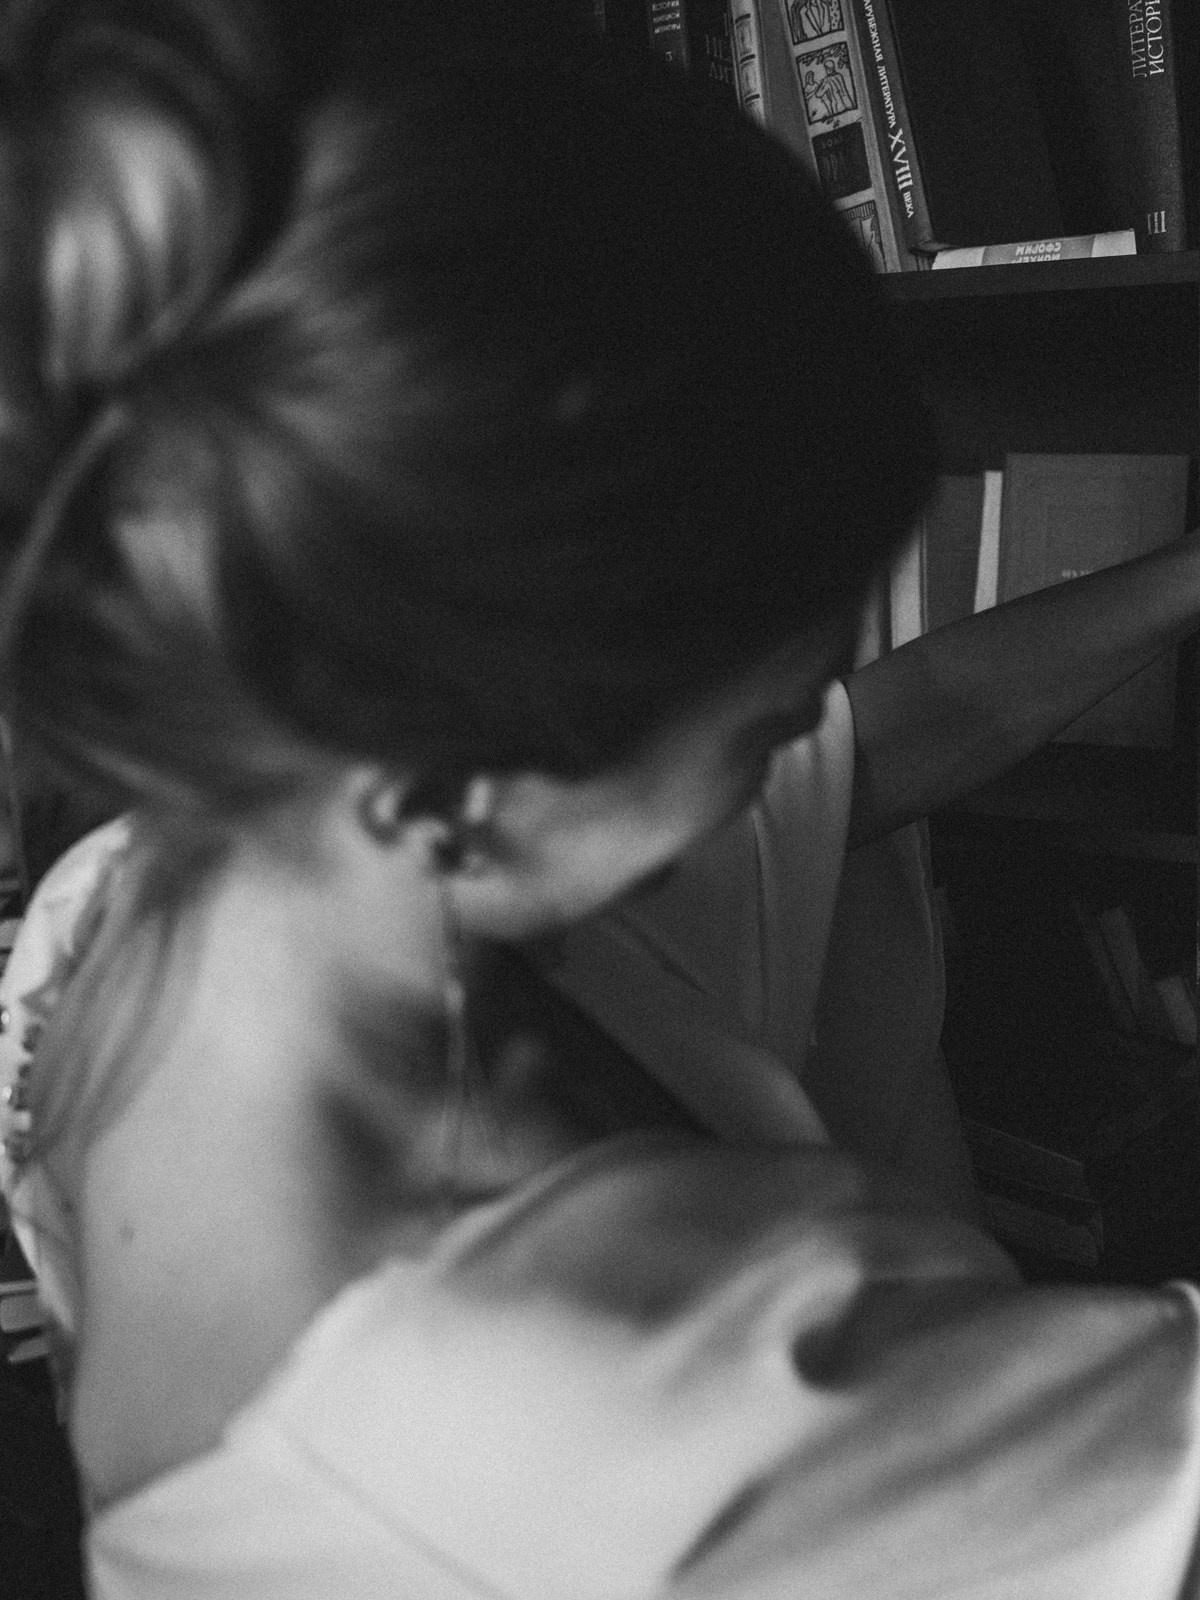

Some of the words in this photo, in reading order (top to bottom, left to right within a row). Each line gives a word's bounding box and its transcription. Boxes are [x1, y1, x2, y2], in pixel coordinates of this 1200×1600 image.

[1127, 0, 1147, 78] ЛИТЕРА
[876, 64, 897, 129] ЛИТЕРАТУРА
[888, 128, 914, 191] XVIII
[902, 191, 914, 219] ВЕКА
[1015, 241, 1061, 256] СФОРИМ
